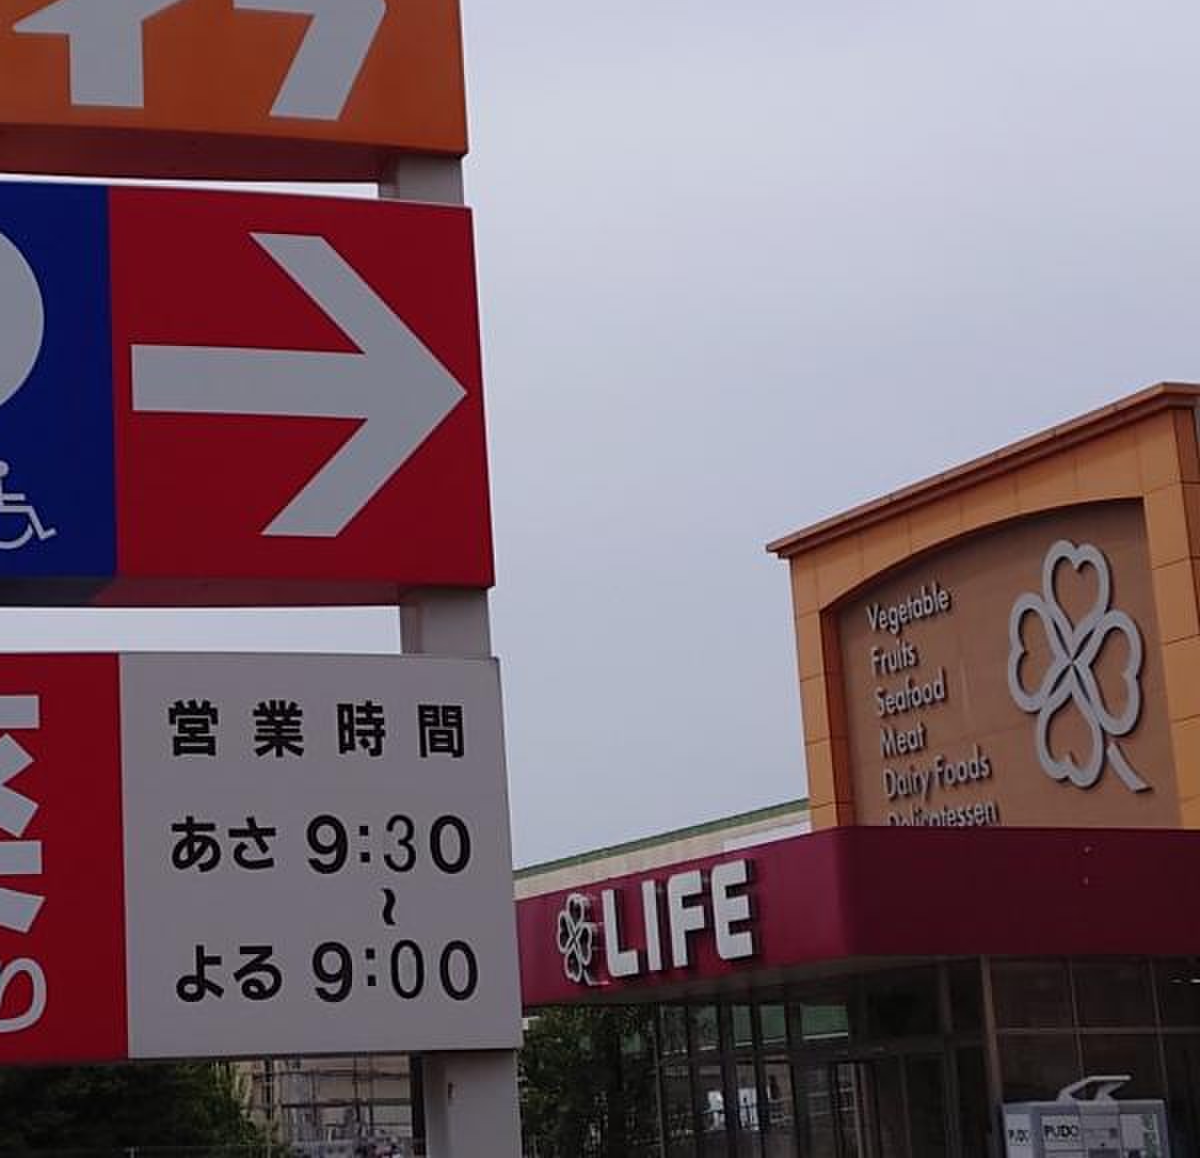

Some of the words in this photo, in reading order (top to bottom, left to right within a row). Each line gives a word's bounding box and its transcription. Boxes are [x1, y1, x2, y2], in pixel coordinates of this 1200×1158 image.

[866, 581, 951, 635] Vegetable
[871, 640, 917, 675] Fruits
[876, 667, 946, 717] Seafood
[168, 699, 465, 758] 営業時間
[880, 722, 925, 757] Meat
[882, 764, 930, 802] Dairy
[934, 744, 991, 784] Foods
[171, 815, 276, 873] あさ
[306, 814, 471, 874] 9:30
[601, 859, 753, 977] LIFE
[175, 944, 283, 1002] よる
[311, 939, 478, 1003] 9:00
